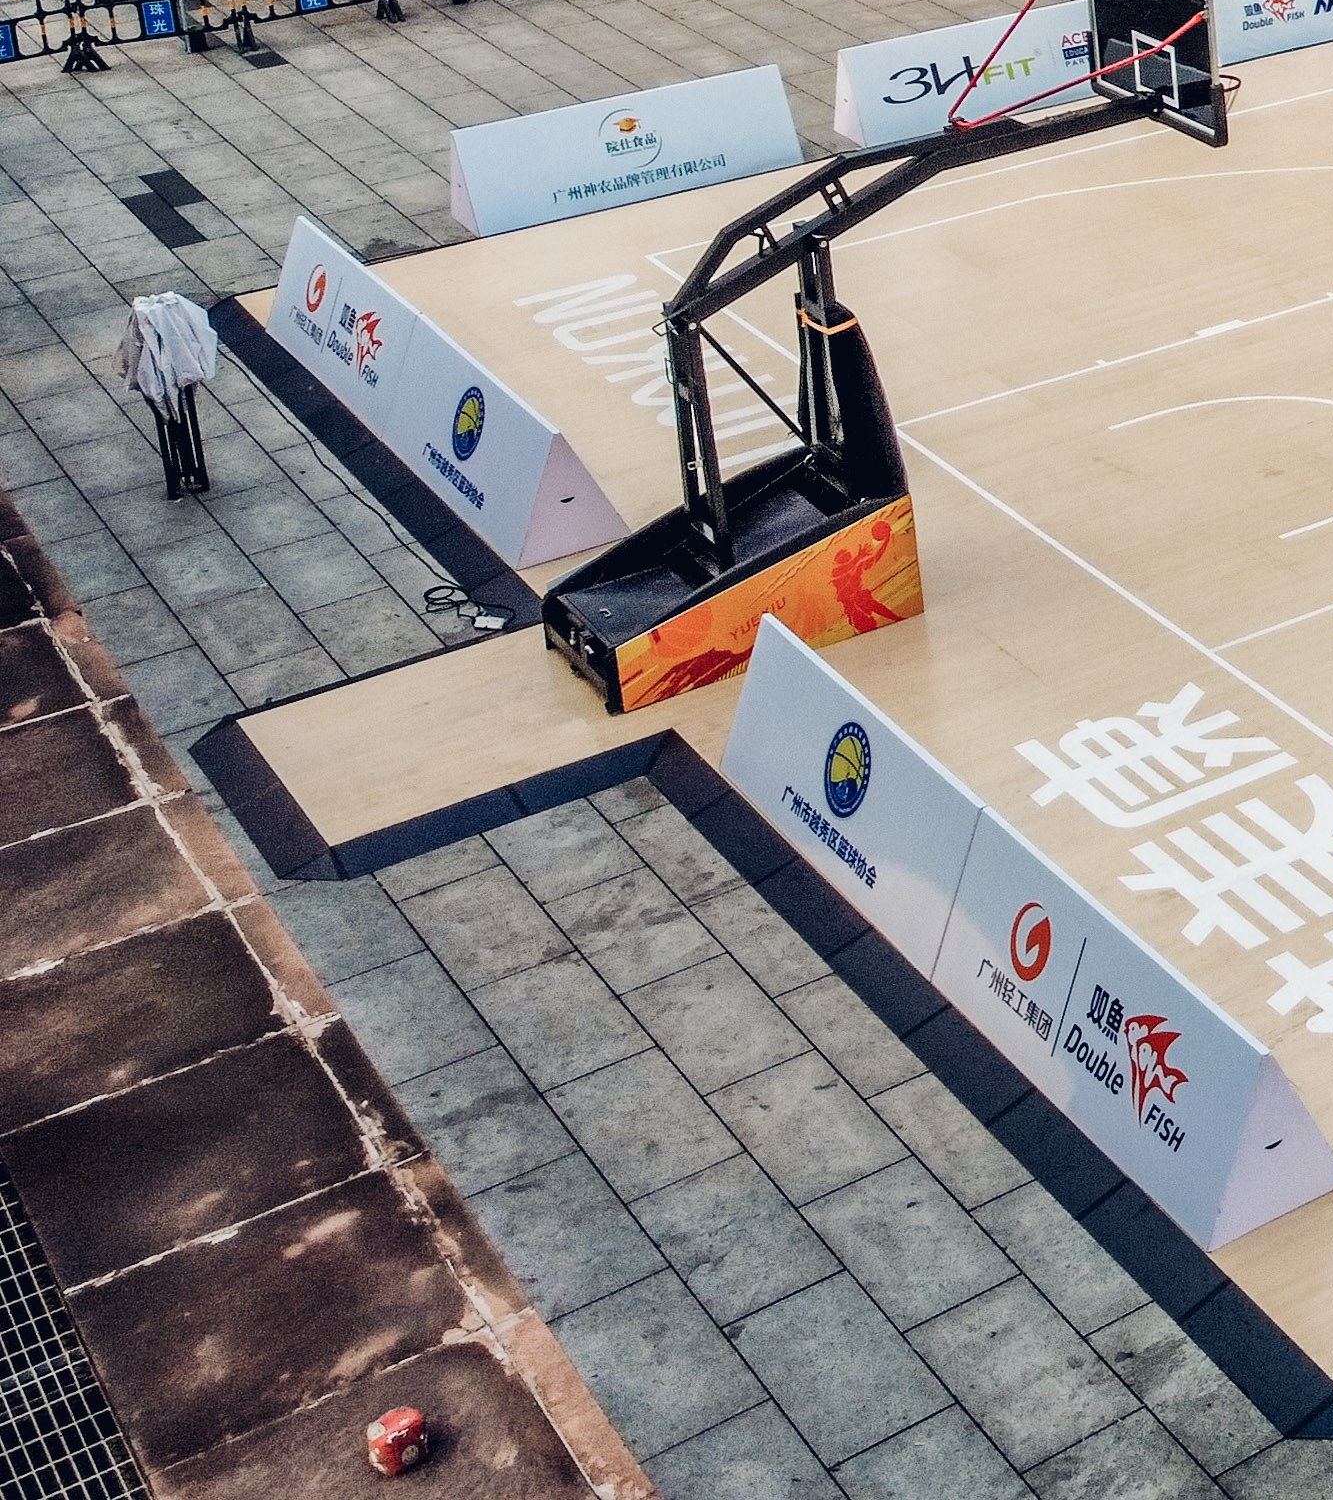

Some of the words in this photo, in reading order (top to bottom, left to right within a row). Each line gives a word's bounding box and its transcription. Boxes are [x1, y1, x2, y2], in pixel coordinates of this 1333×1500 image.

[149, 3, 168, 33] 珠光
[1242, 15, 1274, 31] Double
[1287, 8, 1305, 22] FISH
[605, 132, 657, 154] 院仕食品
[552, 154, 727, 204] 广州神农品牌管理有限公司
[289, 305, 324, 346] 广州轻工集团
[326, 331, 354, 367] Double
[361, 364, 379, 388] FISH
[422, 442, 485, 511] 广州市越秀区篮球协会
[781, 786, 878, 889] 广州市越秀区篮球协会
[977, 958, 1054, 1041] 广州轻工集团
[1063, 1024, 1125, 1095] Double
[1144, 1104, 1186, 1152] FISH
